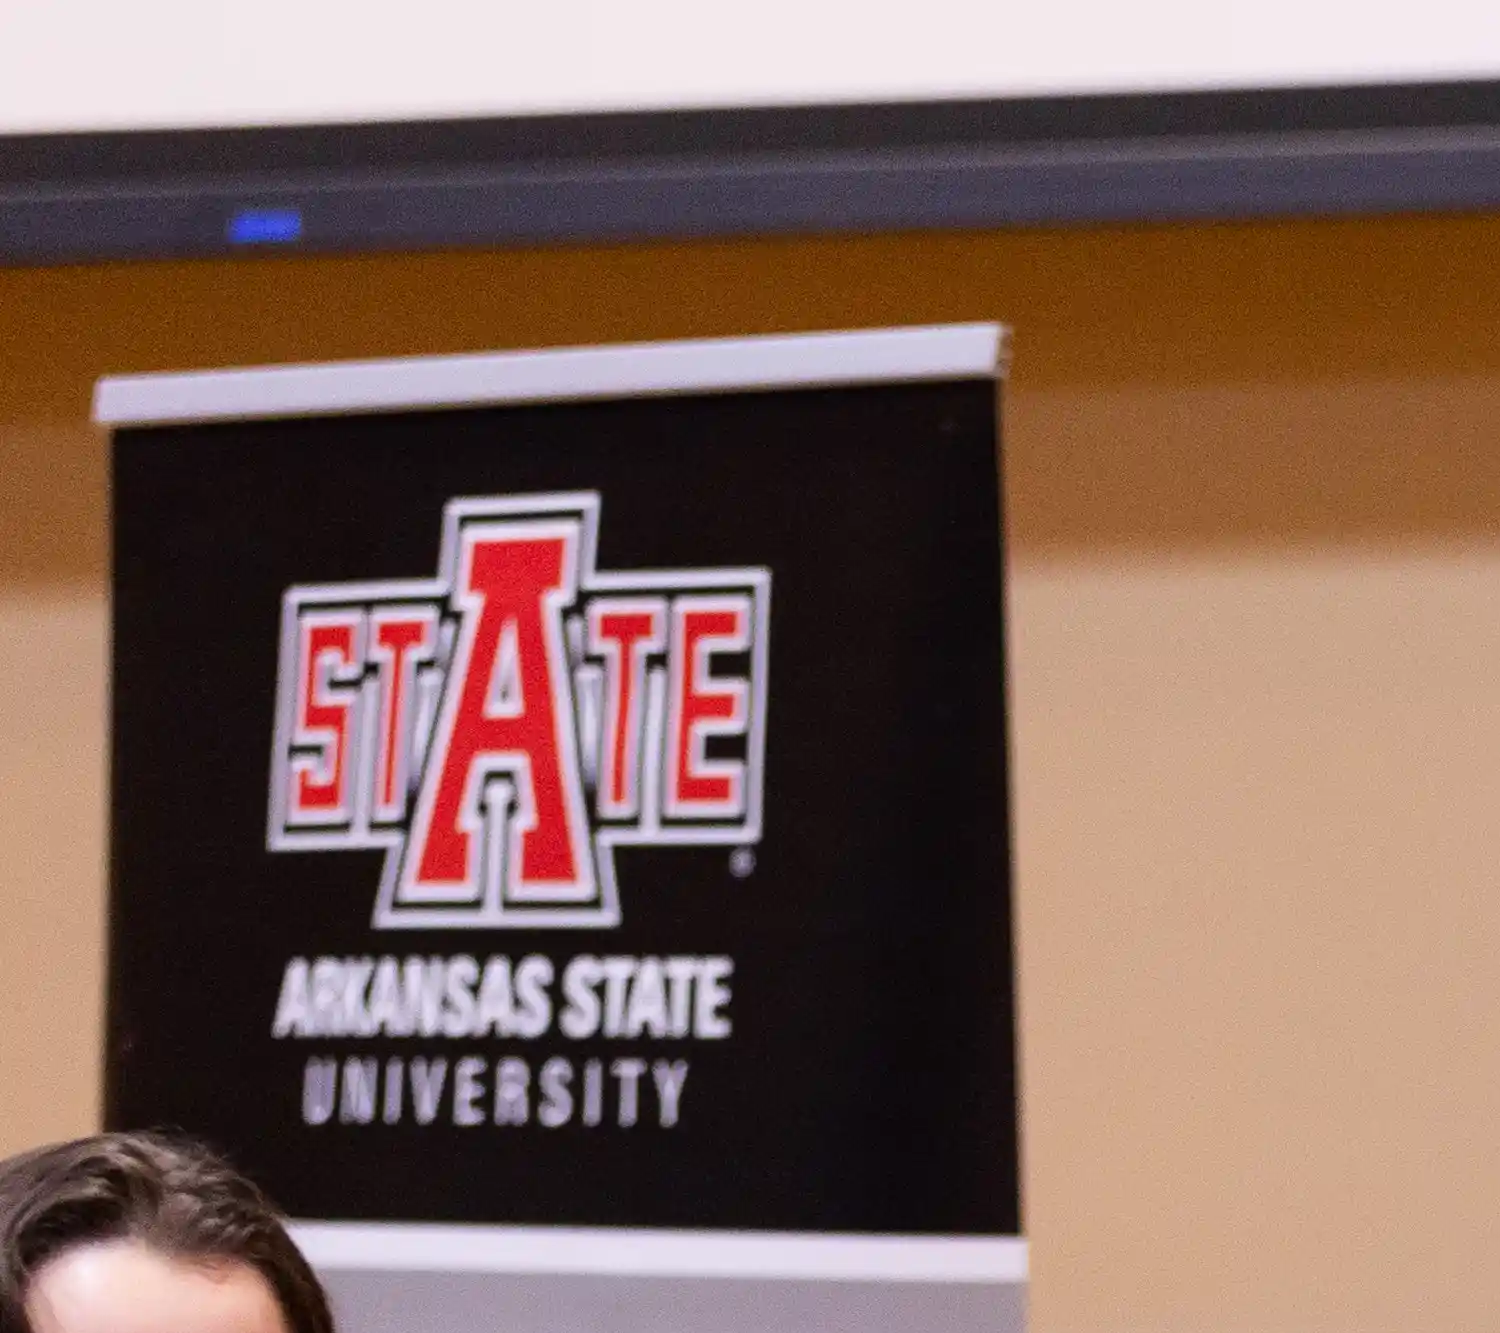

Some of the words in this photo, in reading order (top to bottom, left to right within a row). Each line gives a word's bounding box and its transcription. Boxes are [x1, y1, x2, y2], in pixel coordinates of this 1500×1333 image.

[272, 500, 766, 920] STATE
[272, 954, 555, 1039] ARKANSAS
[558, 954, 734, 1039] STATE
[302, 1056, 688, 1128] UNIVERSITY
